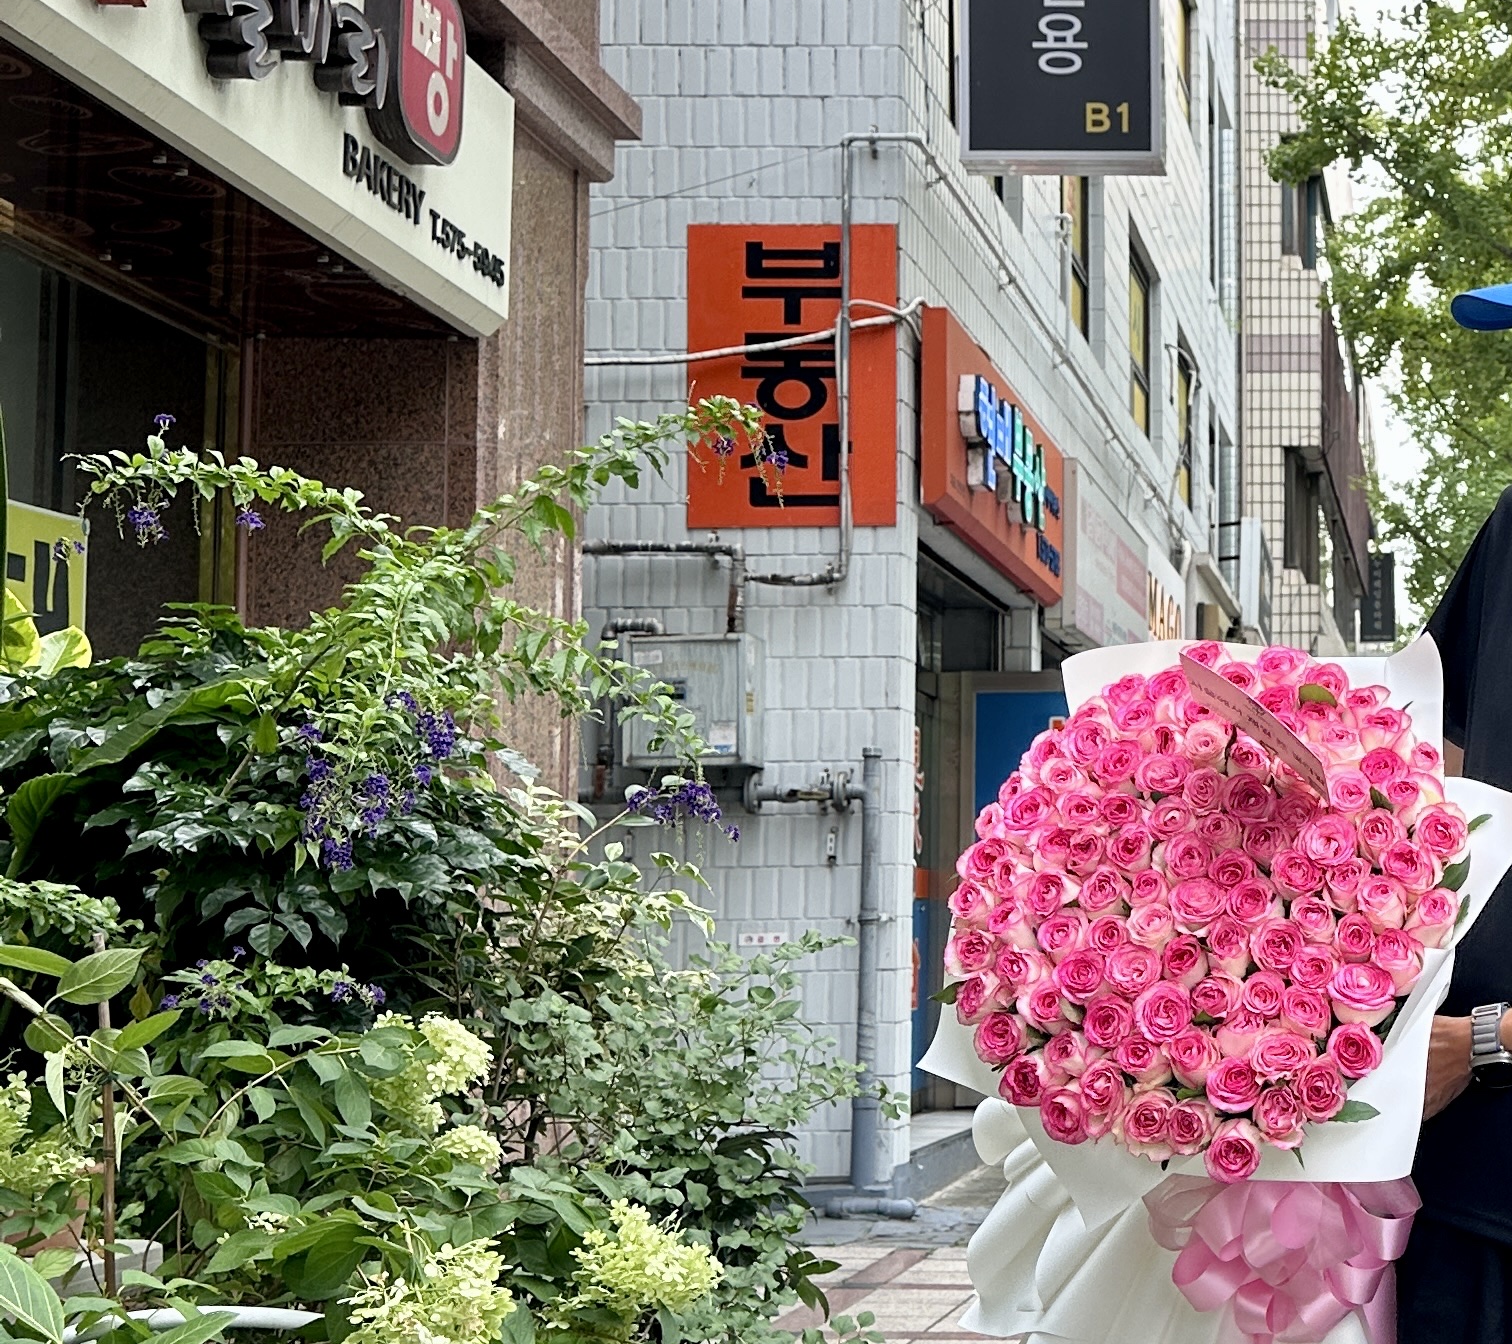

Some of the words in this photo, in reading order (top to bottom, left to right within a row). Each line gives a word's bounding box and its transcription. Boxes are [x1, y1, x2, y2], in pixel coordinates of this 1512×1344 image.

[1084, 101, 1131, 134] B1
[342, 132, 426, 227] BAKERY
[740, 240, 853, 508] 부동산
